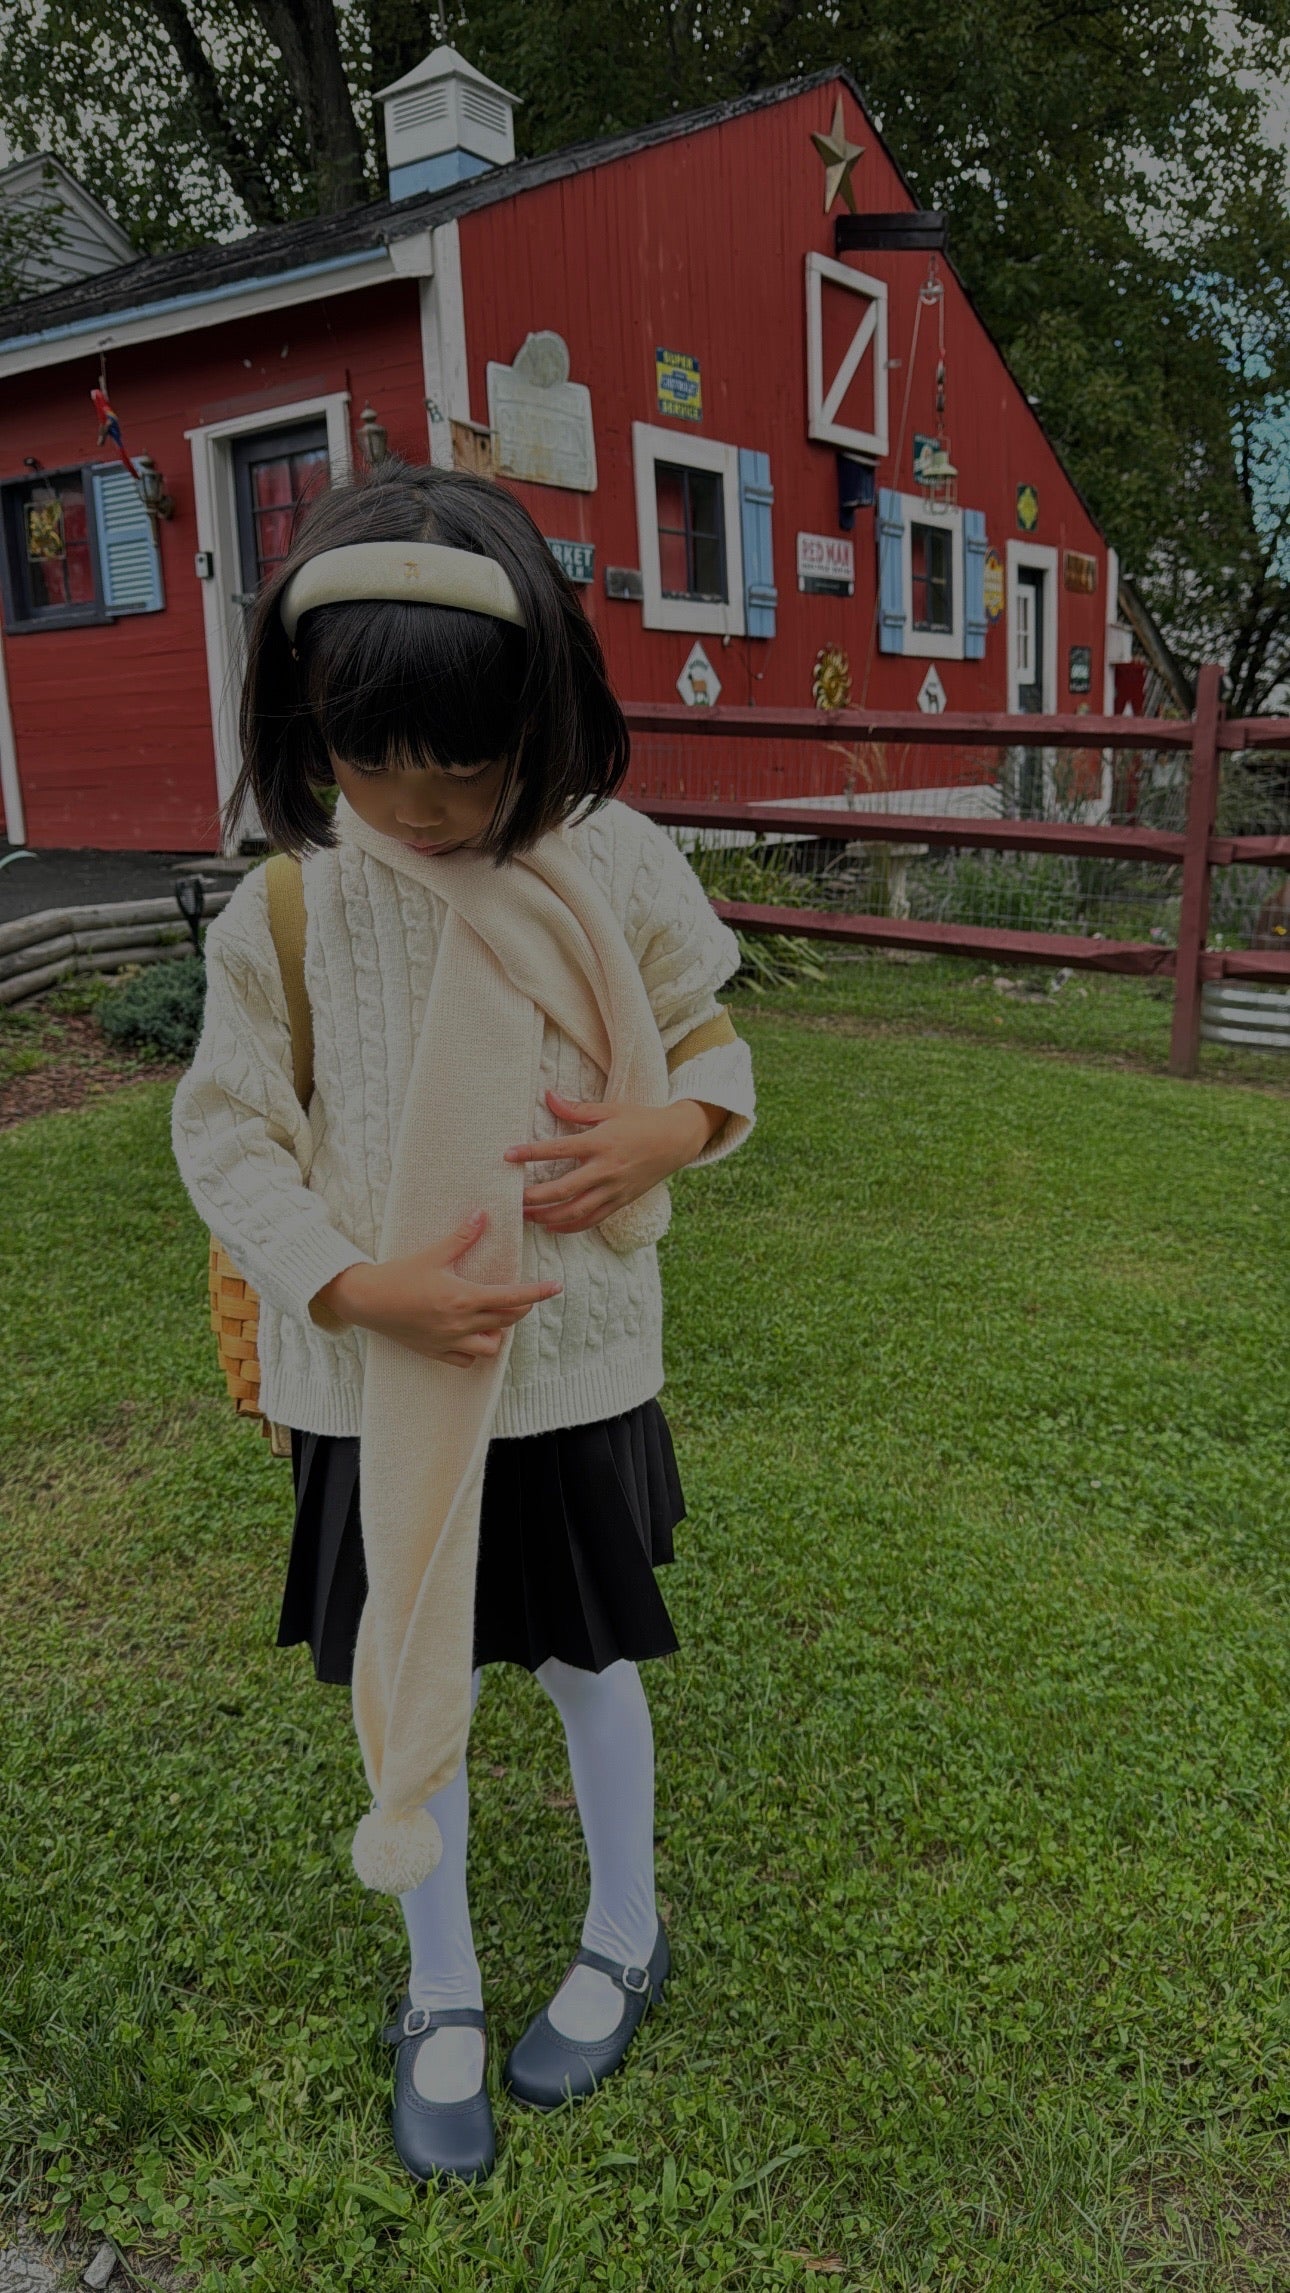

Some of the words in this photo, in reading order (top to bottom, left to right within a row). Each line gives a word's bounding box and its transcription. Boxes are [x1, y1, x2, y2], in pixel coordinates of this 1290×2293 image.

[663, 350, 694, 370] SUPER
[662, 400, 699, 418] SERVICE
[551, 544, 593, 566] RKET
[802, 539, 824, 562] RED
[826, 543, 849, 565] MAN
